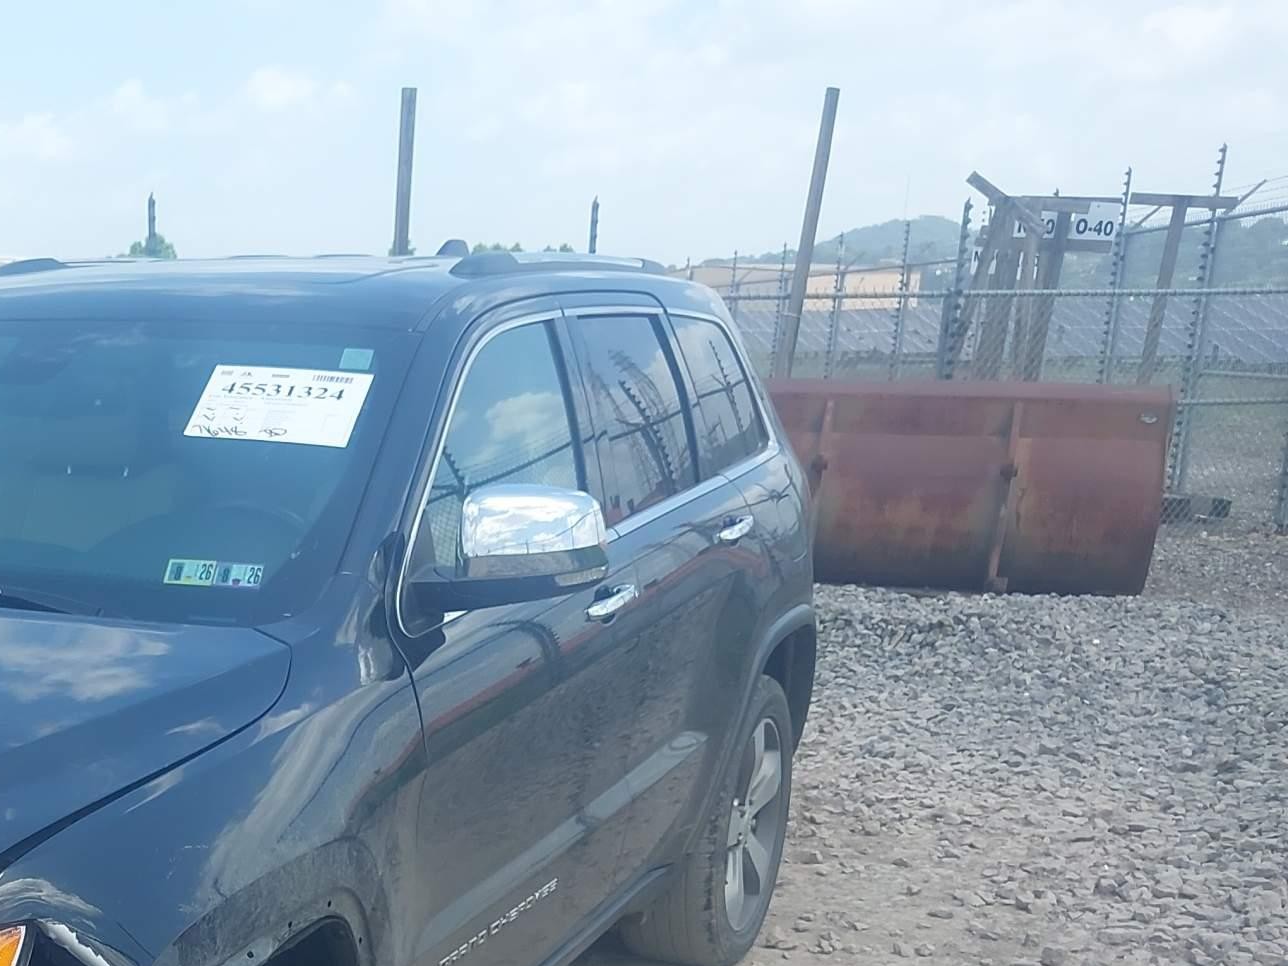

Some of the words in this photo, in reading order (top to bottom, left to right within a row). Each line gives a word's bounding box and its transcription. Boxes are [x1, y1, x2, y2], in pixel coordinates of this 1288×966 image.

[1074, 217, 1114, 237] O-40
[221, 381, 345, 401] 45531324
[198, 563, 214, 581] 26
[247, 566, 262, 585] 26
